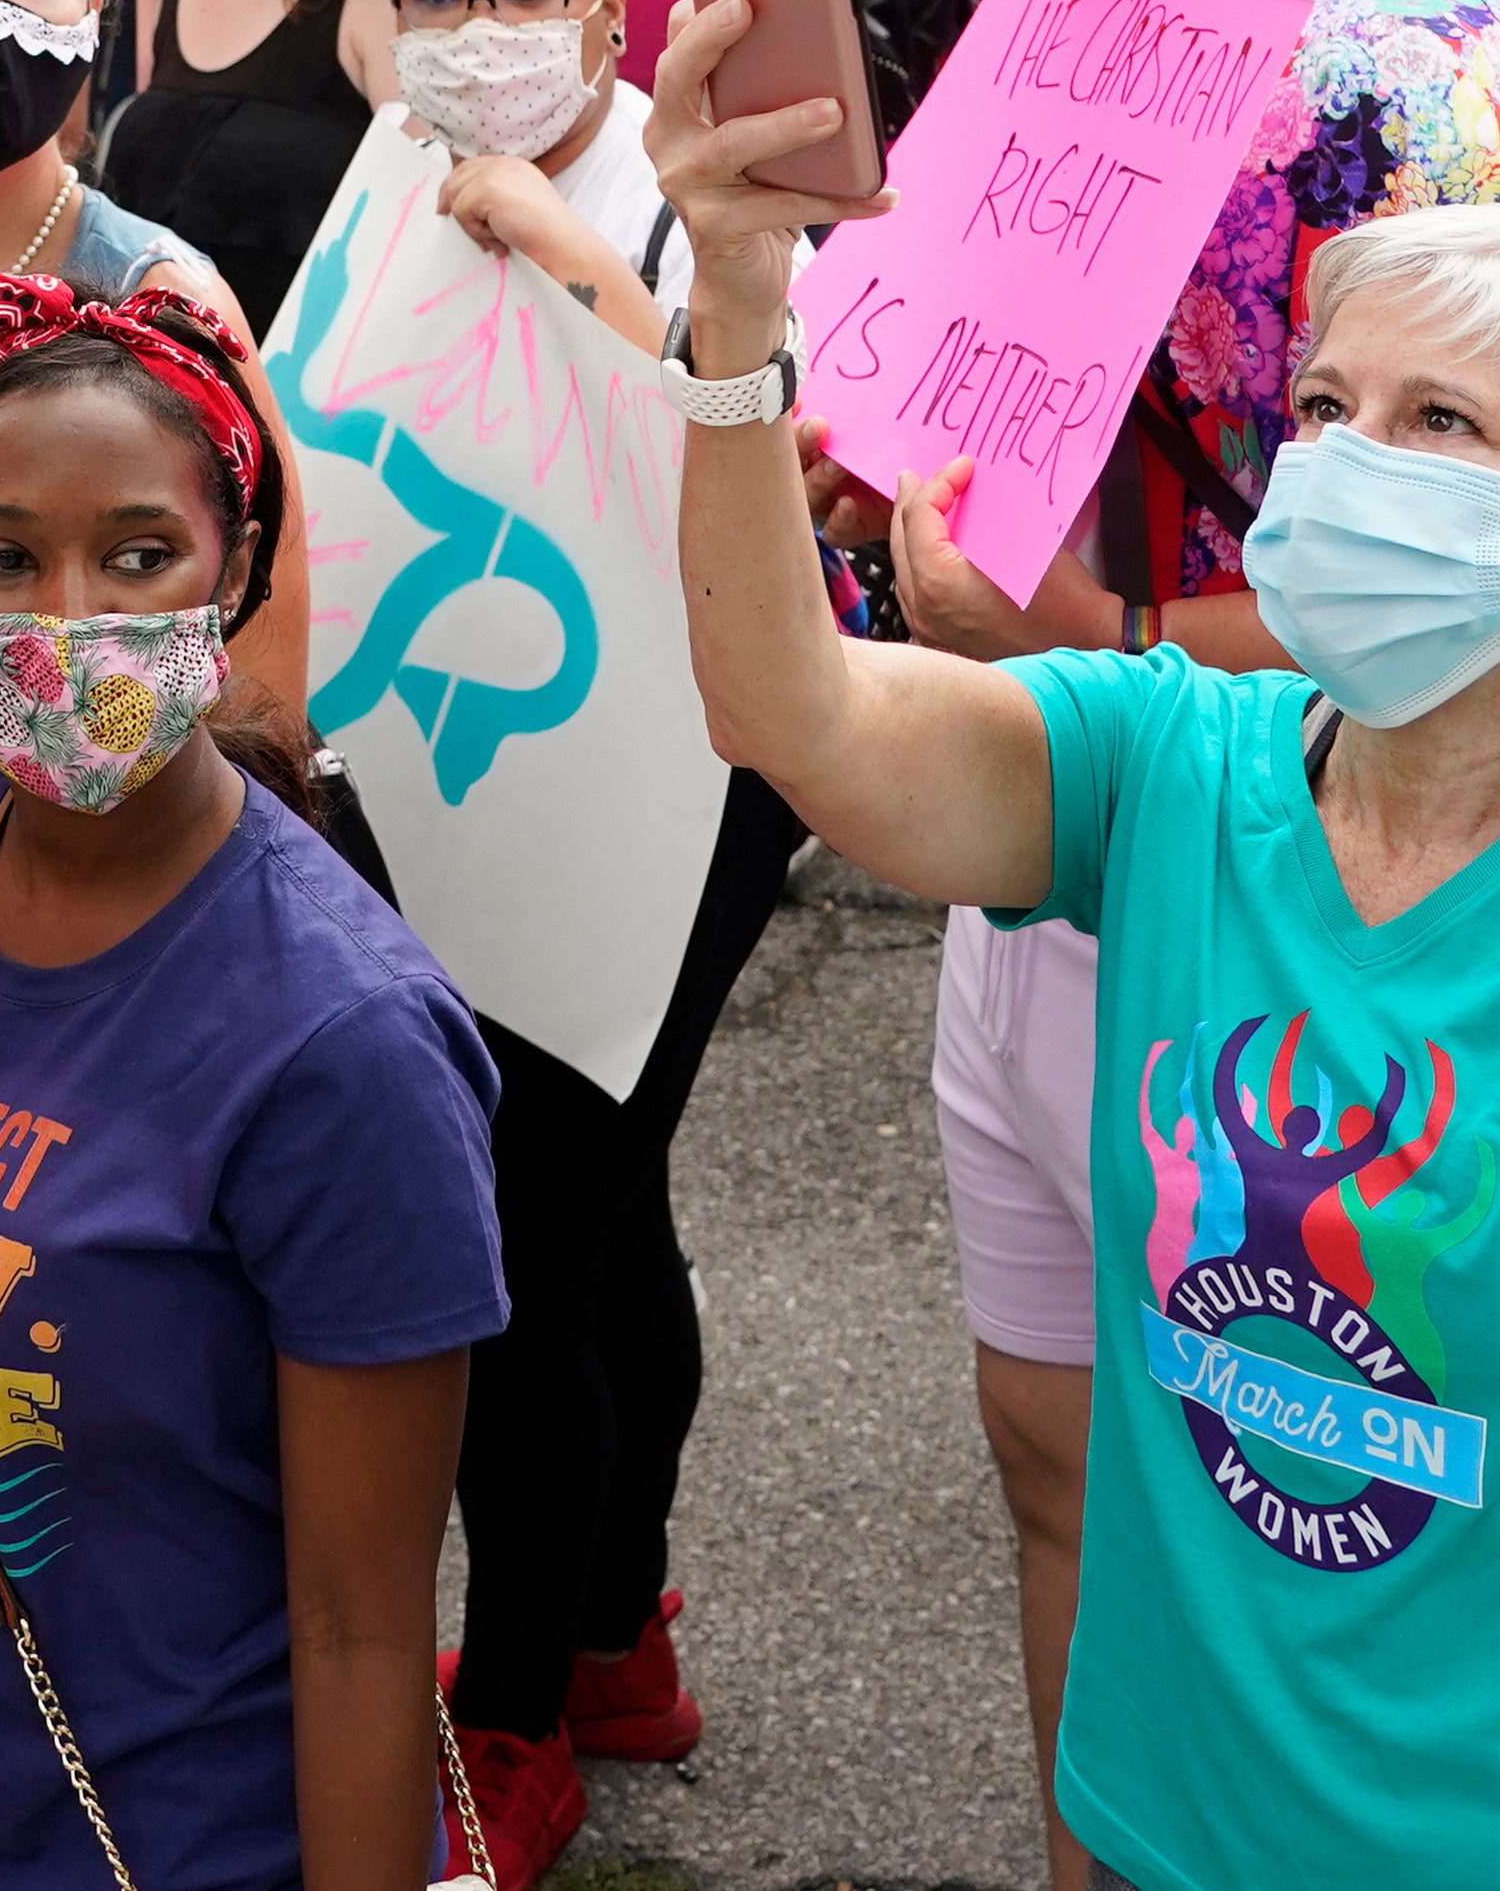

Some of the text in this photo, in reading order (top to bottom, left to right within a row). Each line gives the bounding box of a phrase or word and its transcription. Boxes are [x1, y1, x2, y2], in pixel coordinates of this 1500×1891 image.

[962, 132, 1163, 278] RIGHT
[811, 277, 905, 380] IS
[1174, 1262, 1407, 1384] HOUSTON
[1172, 1327, 1448, 1479] March ON
[1213, 1443, 1394, 1566] WOMEN
